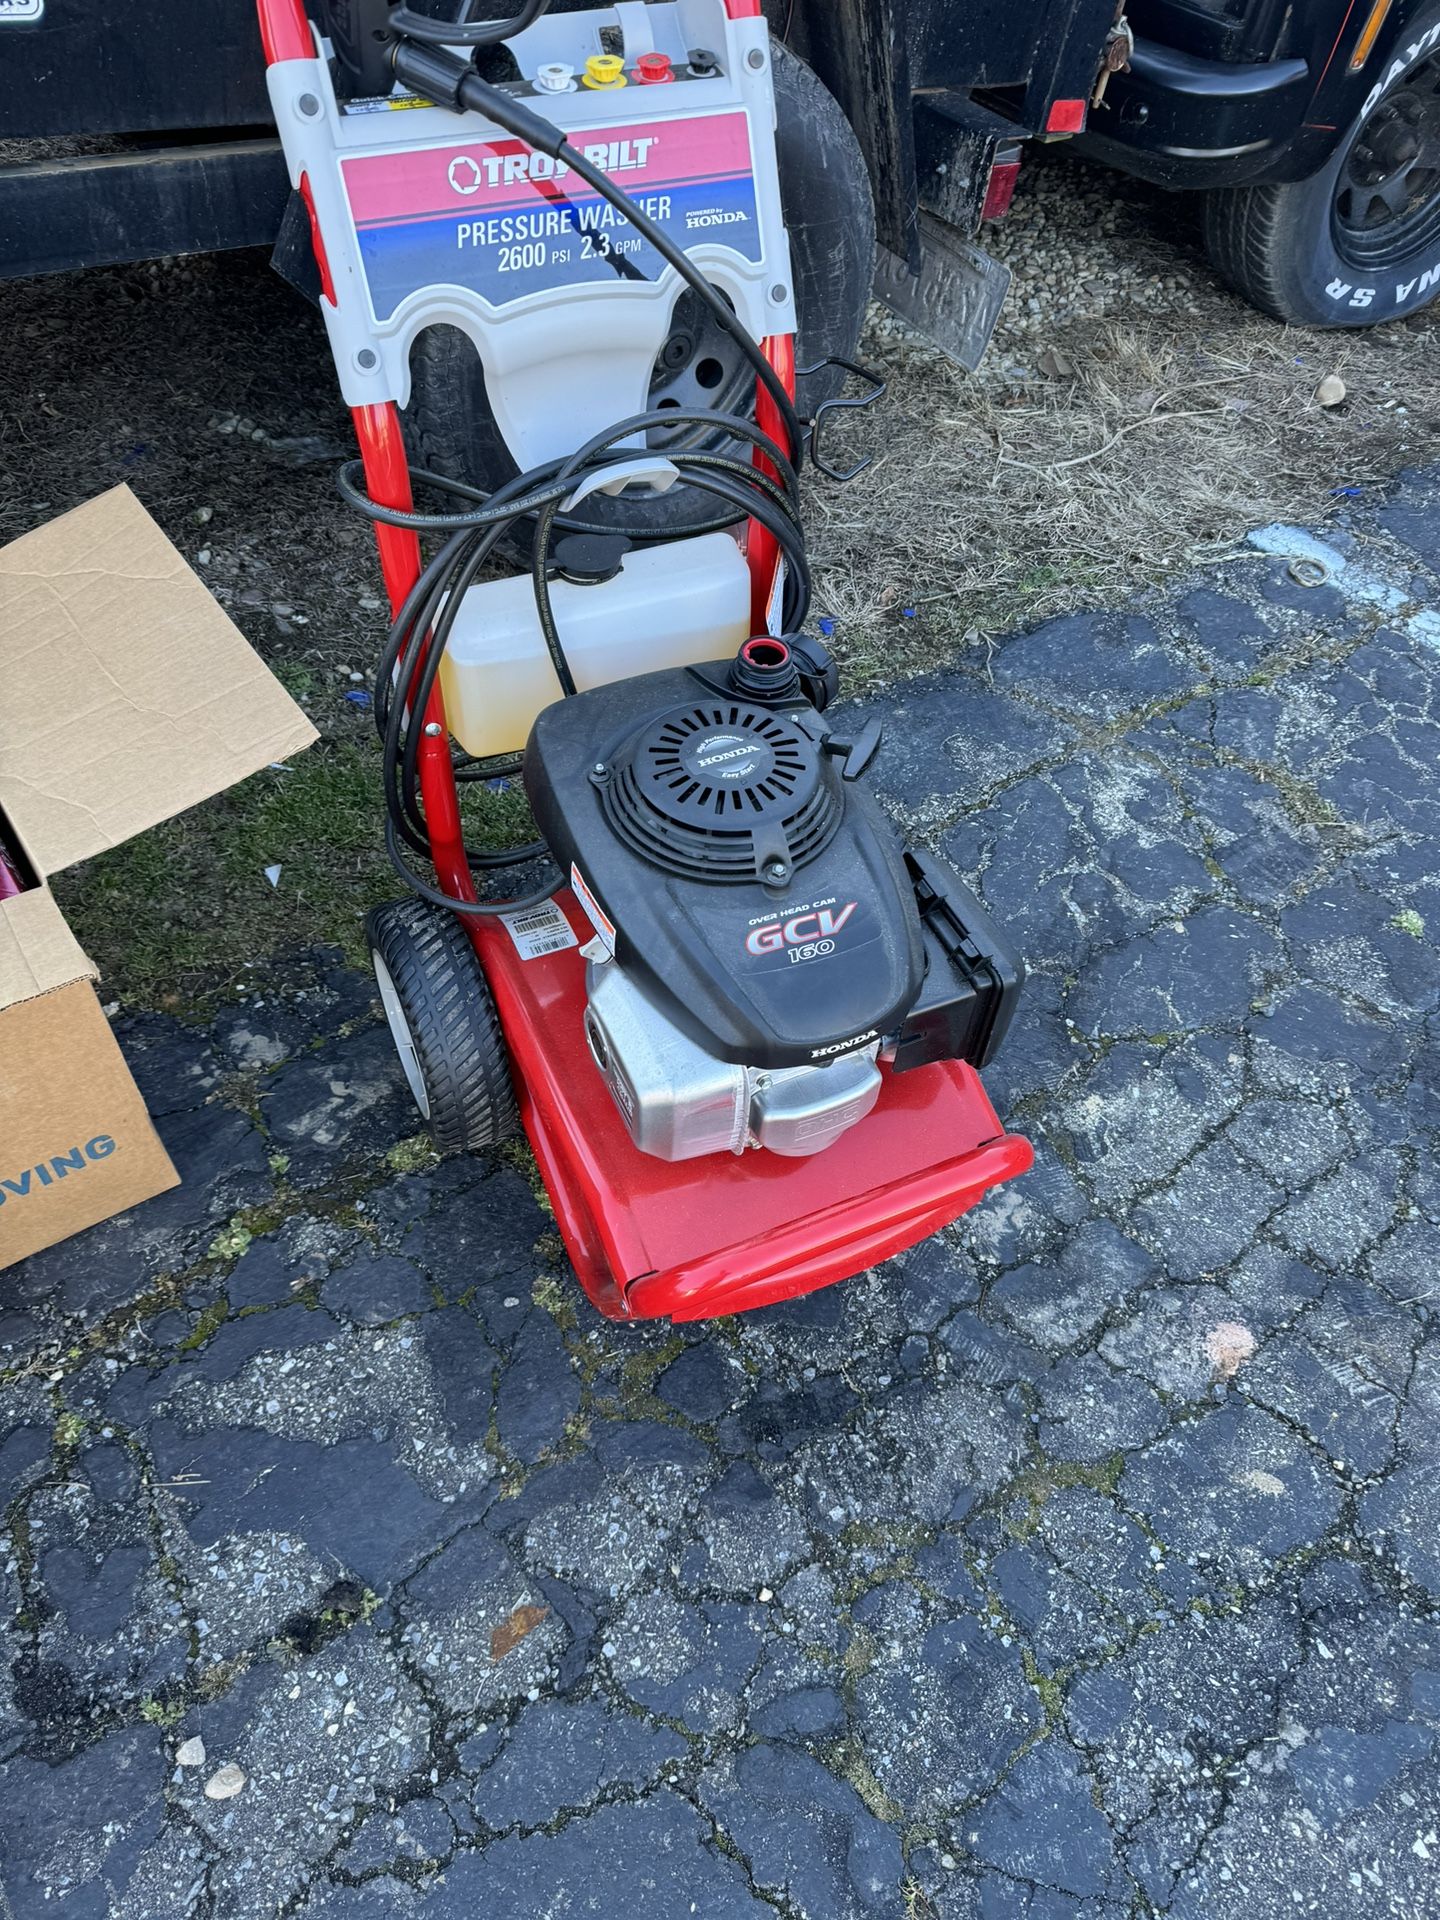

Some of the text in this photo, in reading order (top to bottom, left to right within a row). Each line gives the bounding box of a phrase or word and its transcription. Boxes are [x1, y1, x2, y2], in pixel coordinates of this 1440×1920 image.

[482, 138, 654, 187] TROYBILT
[457, 209, 572, 248] PRESSURE
[686, 211, 749, 228] HONDA
[498, 233, 641, 272] 2600 PSI 2.3 GPM
[1325, 277, 1376, 307] SR
[697, 745, 761, 767] HONDA
[740, 763, 755, 775] Start
[748, 897, 836, 926] OVER HEAD CAM
[745, 902, 858, 955] GCV
[788, 939, 835, 963] 160
[811, 1030, 878, 1058] HONDA
[0, 1134, 116, 1206] VING
